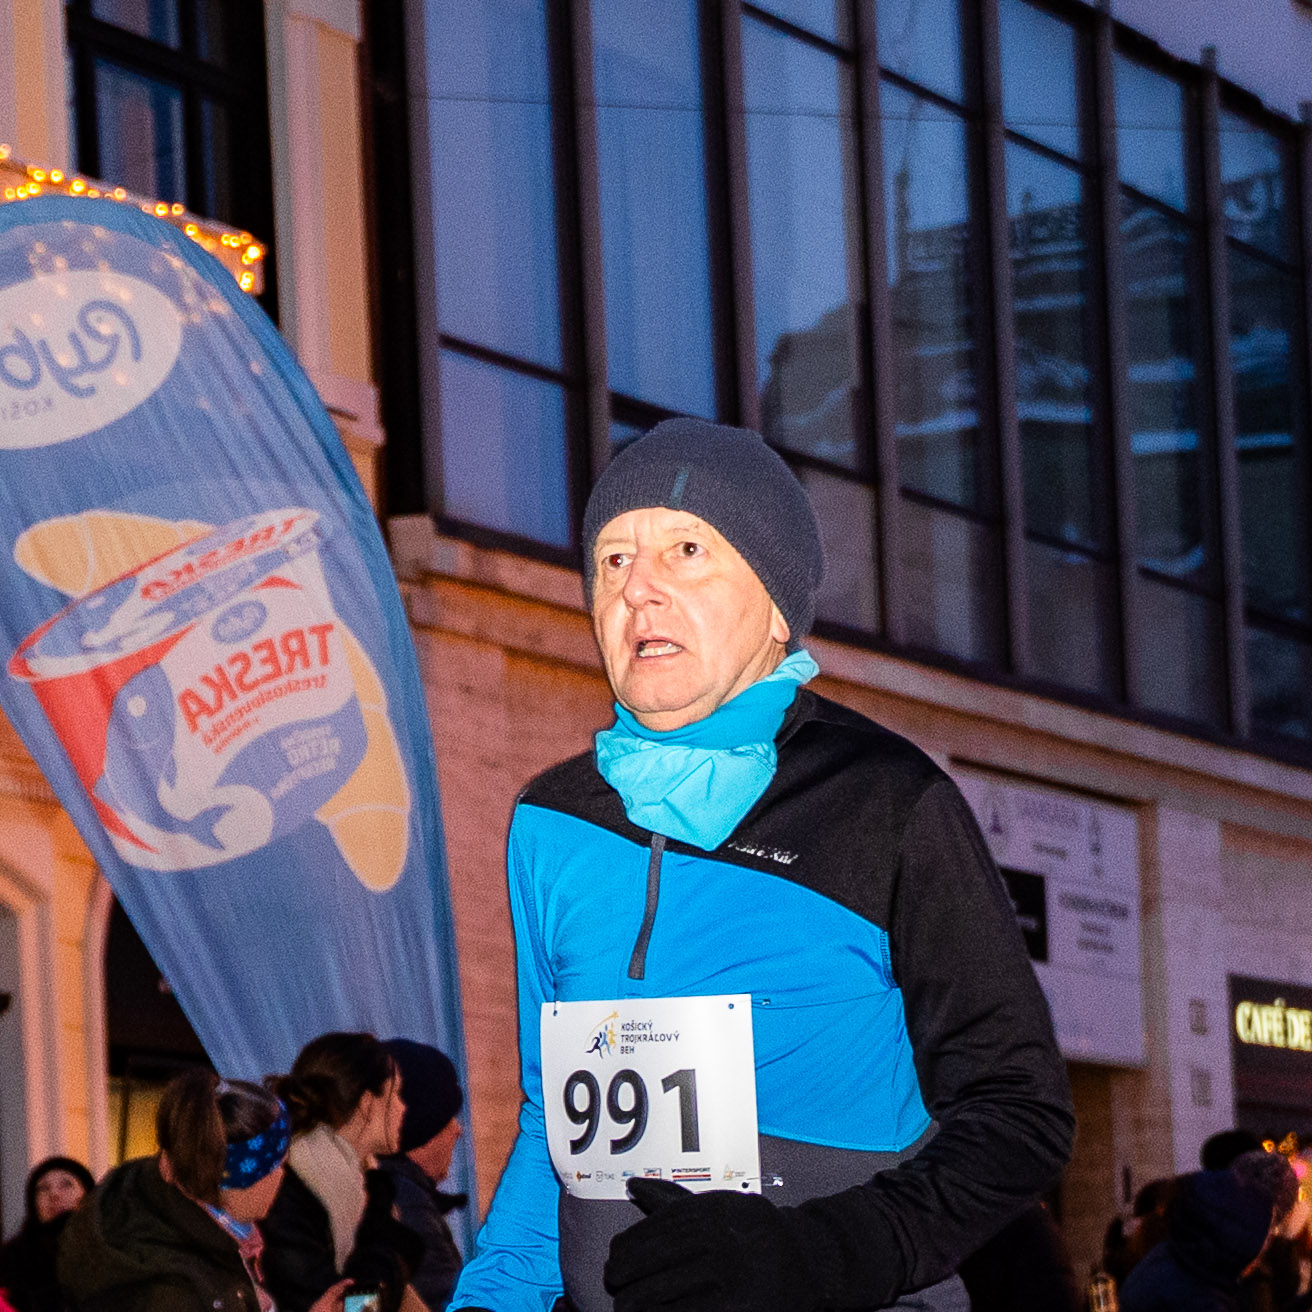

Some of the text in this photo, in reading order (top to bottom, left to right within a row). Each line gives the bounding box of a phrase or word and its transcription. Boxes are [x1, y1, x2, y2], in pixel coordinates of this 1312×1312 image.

[620, 1019, 654, 1031] KOŠICKÝ
[1236, 997, 1286, 1048] CAFÉ
[620, 1045, 635, 1054] BEH
[562, 1068, 701, 1155] 991
